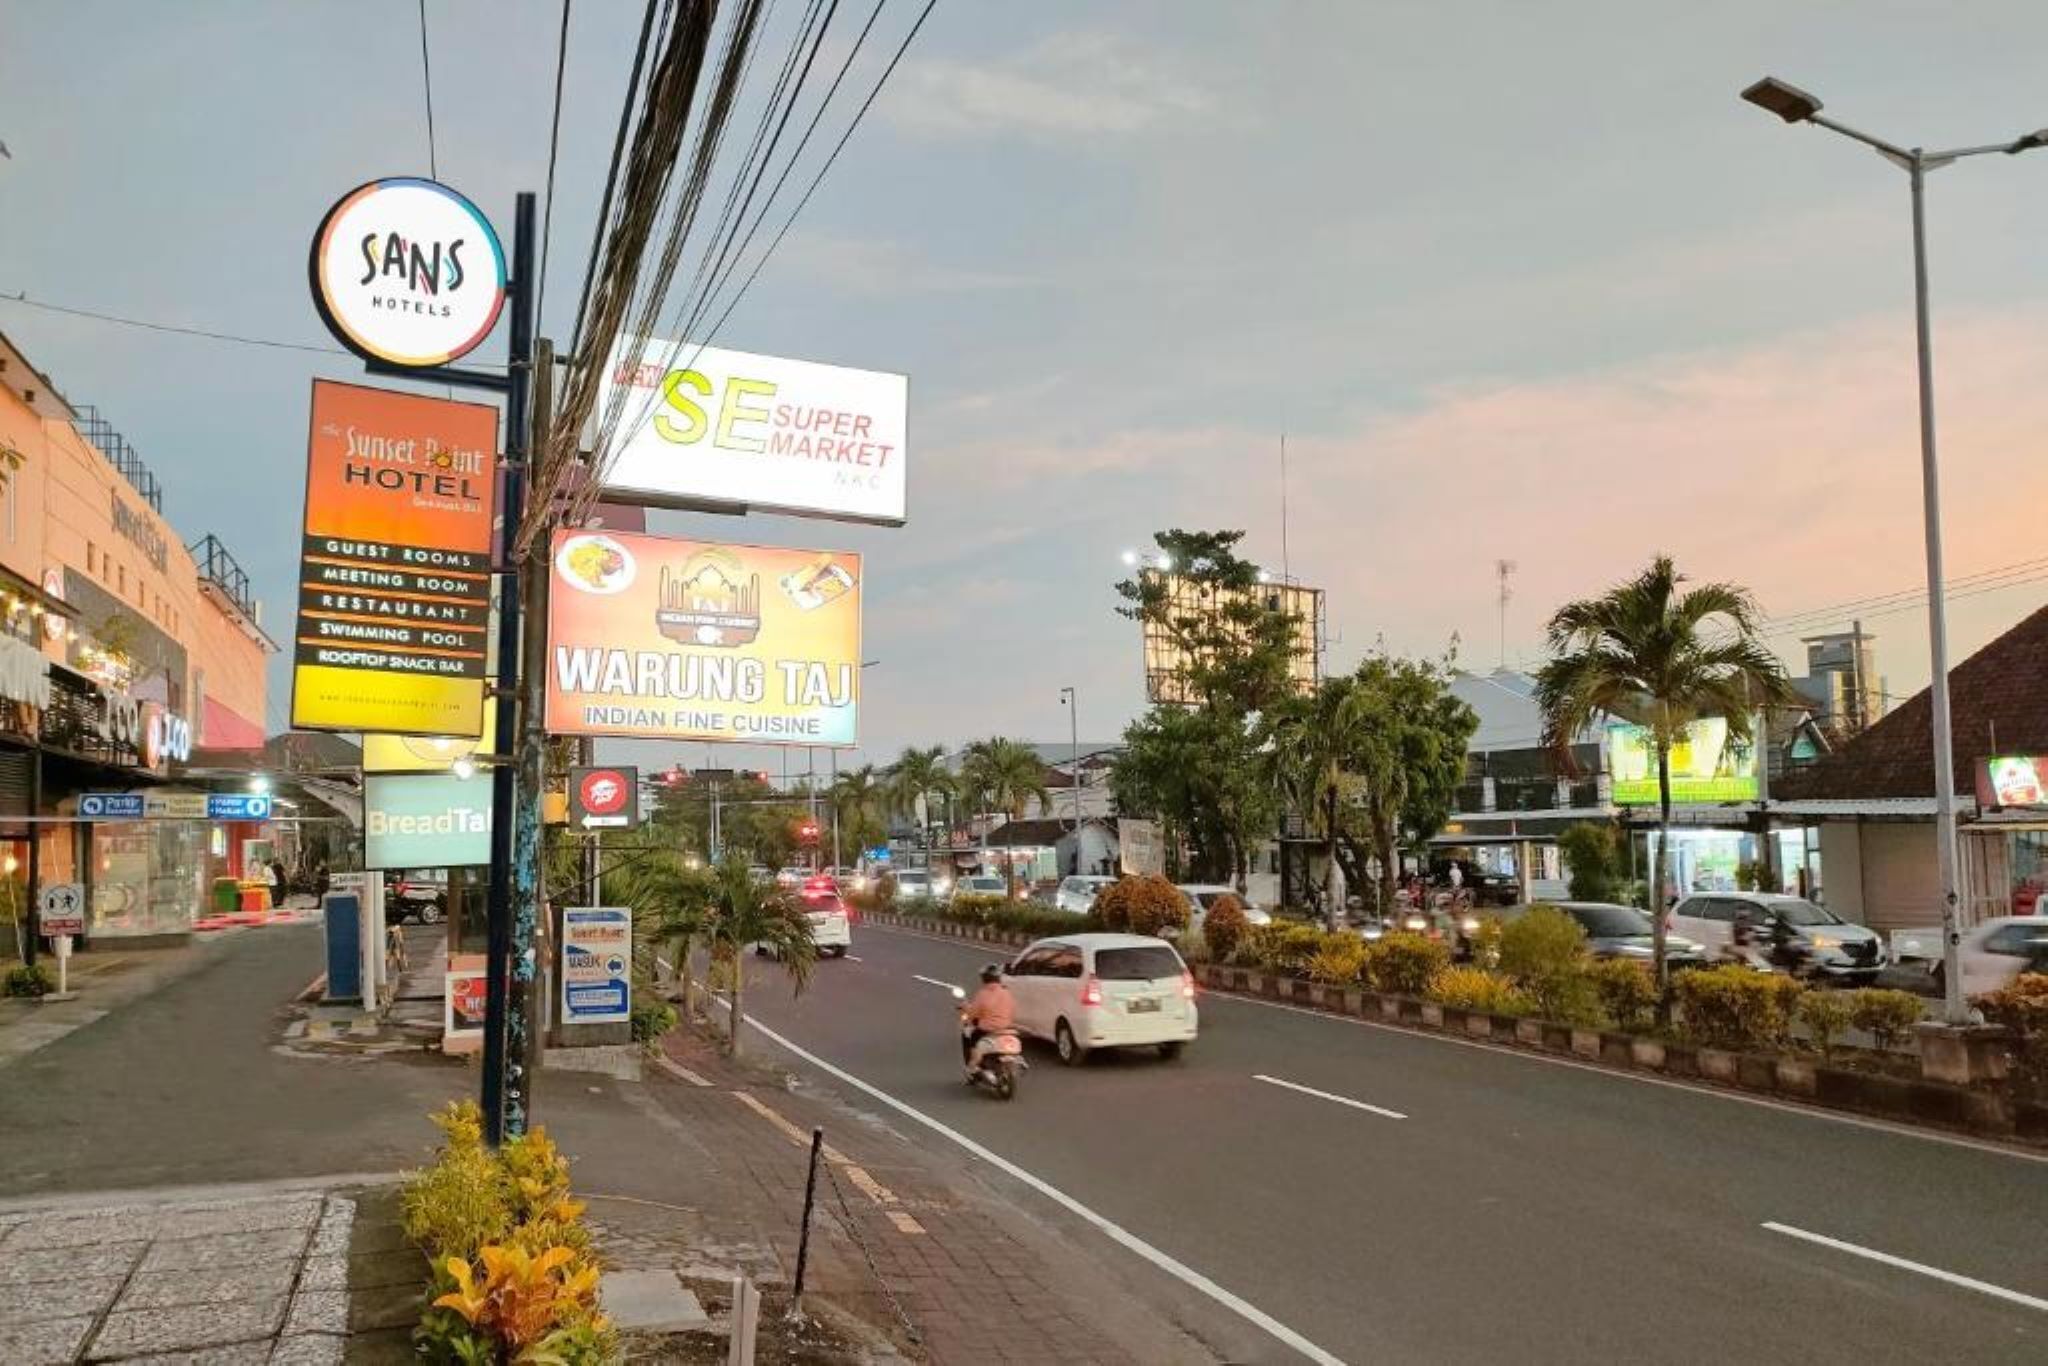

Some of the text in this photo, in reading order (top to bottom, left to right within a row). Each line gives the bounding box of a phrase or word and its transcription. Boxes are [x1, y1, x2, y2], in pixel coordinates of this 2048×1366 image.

[361, 232, 464, 296] SANS
[372, 296, 451, 317] HOTELS
[773, 403, 873, 438] SUPER
[346, 425, 416, 465] Sunset
[769, 430, 895, 469] MARKET
[345, 463, 480, 500] HOTEL
[325, 540, 471, 567] GUEST ROOMS
[322, 567, 469, 593] MEETING ROOM
[322, 595, 469, 620] RESTAURANT
[319, 622, 466, 647] SWIMMING POOL
[318, 649, 465, 673] ROOFTOP SNACK BAR
[555, 645, 857, 709] WARUNG TAJ
[585, 706, 821, 735] INDIAN FINE CUISINE
[367, 806, 493, 836] BreadTal
